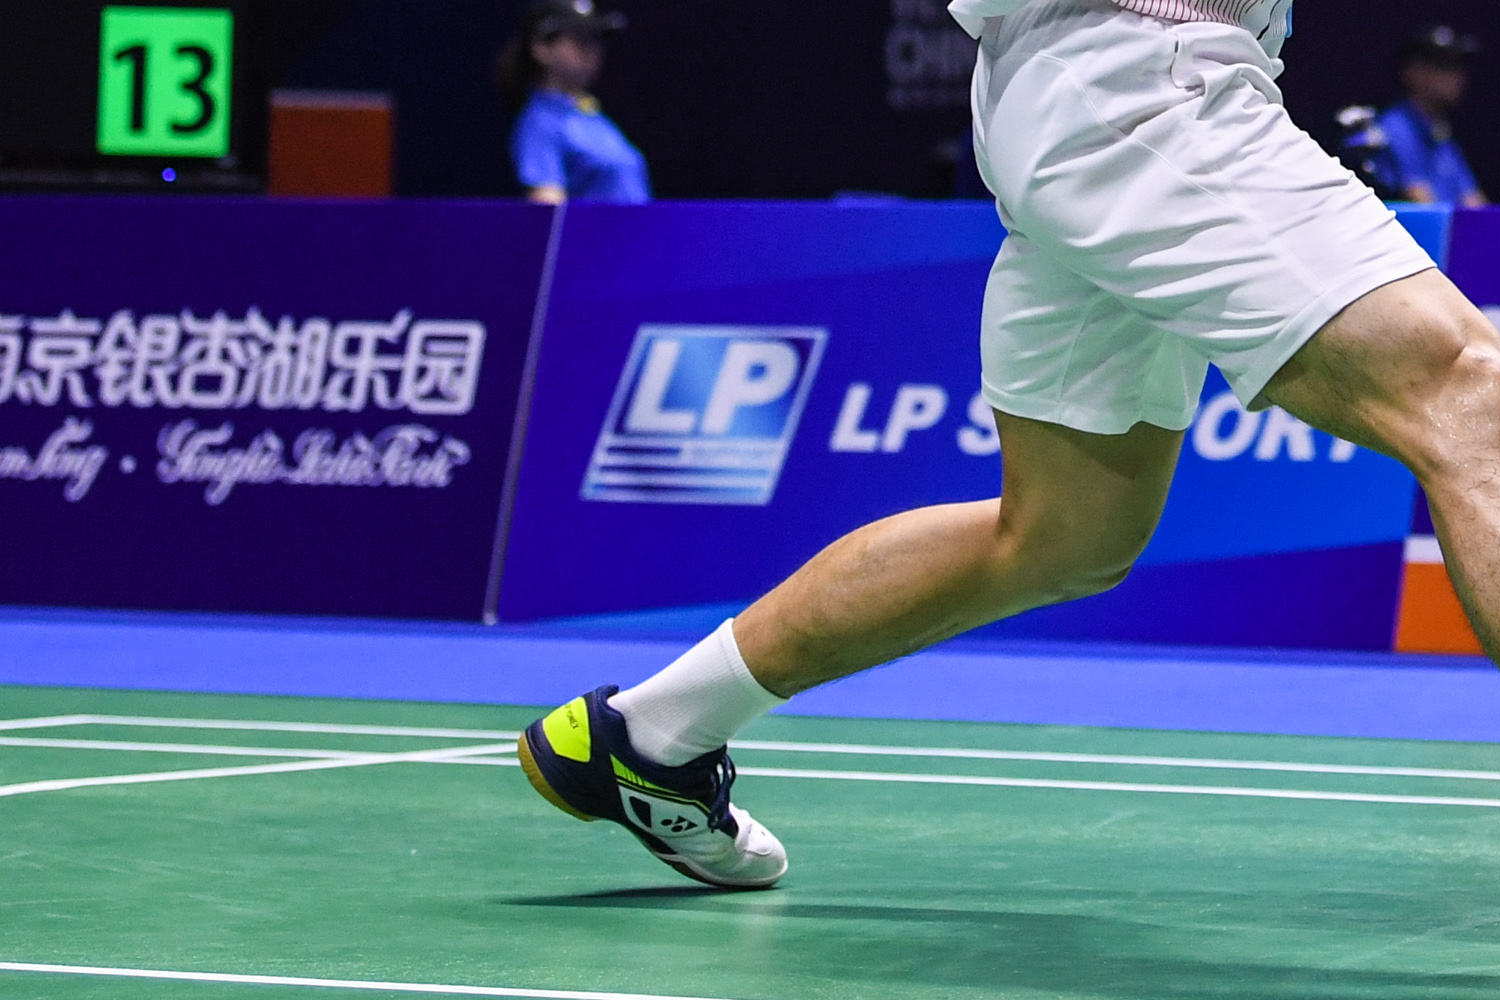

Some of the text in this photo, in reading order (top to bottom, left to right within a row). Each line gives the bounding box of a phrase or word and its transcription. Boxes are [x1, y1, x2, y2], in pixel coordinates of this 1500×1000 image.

[112, 45, 216, 134] 13
[622, 338, 803, 437] LP
[829, 382, 948, 454] LP
